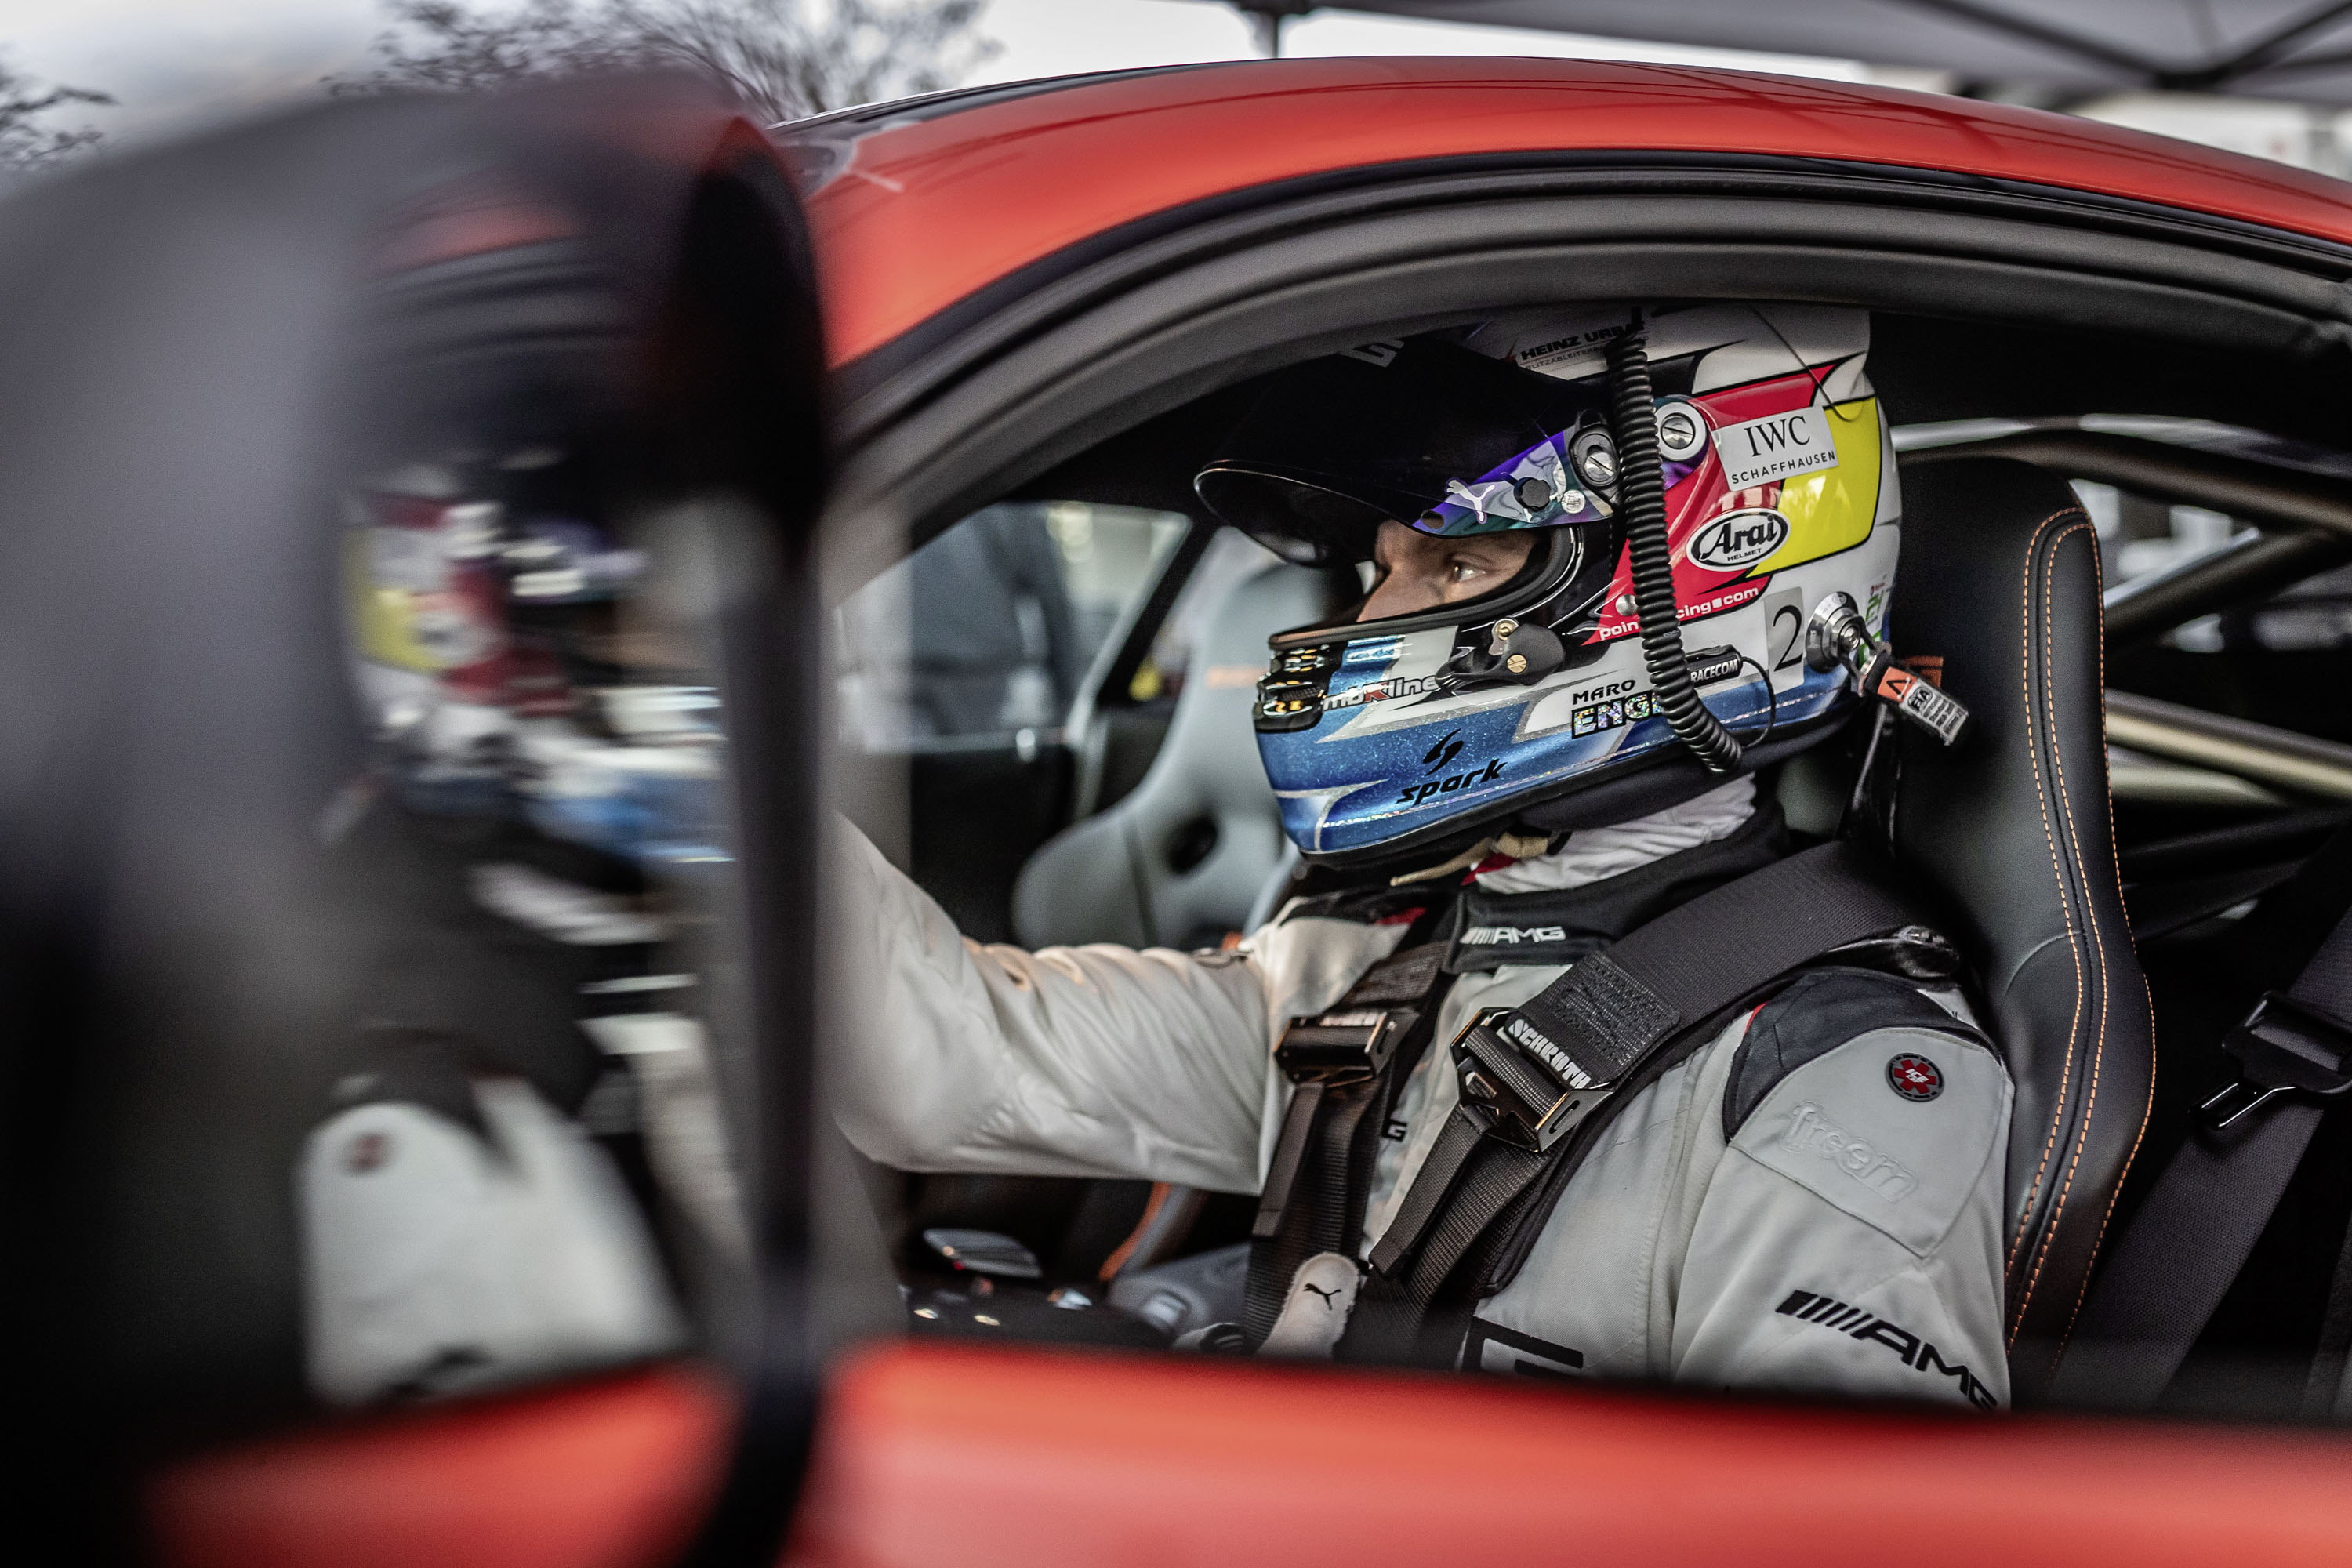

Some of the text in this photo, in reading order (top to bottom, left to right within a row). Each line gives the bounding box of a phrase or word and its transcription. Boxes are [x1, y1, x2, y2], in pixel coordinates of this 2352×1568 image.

[1521, 336, 1581, 361] HEINZ
[1744, 416, 1810, 457] IWC
[1731, 450, 1835, 485] SCHAFFHAUSEN
[1700, 514, 1778, 560] Arai
[1727, 548, 1762, 561] HELMET
[1773, 604, 1803, 672] 2
[1690, 659, 1738, 682] RACECOM
[1573, 680, 1635, 705] MARO
[1572, 690, 1663, 739] ENG
[1395, 758, 1508, 806] spark
[1490, 926, 1566, 944] AMG
[1508, 1018, 1592, 1090] SCHROTH
